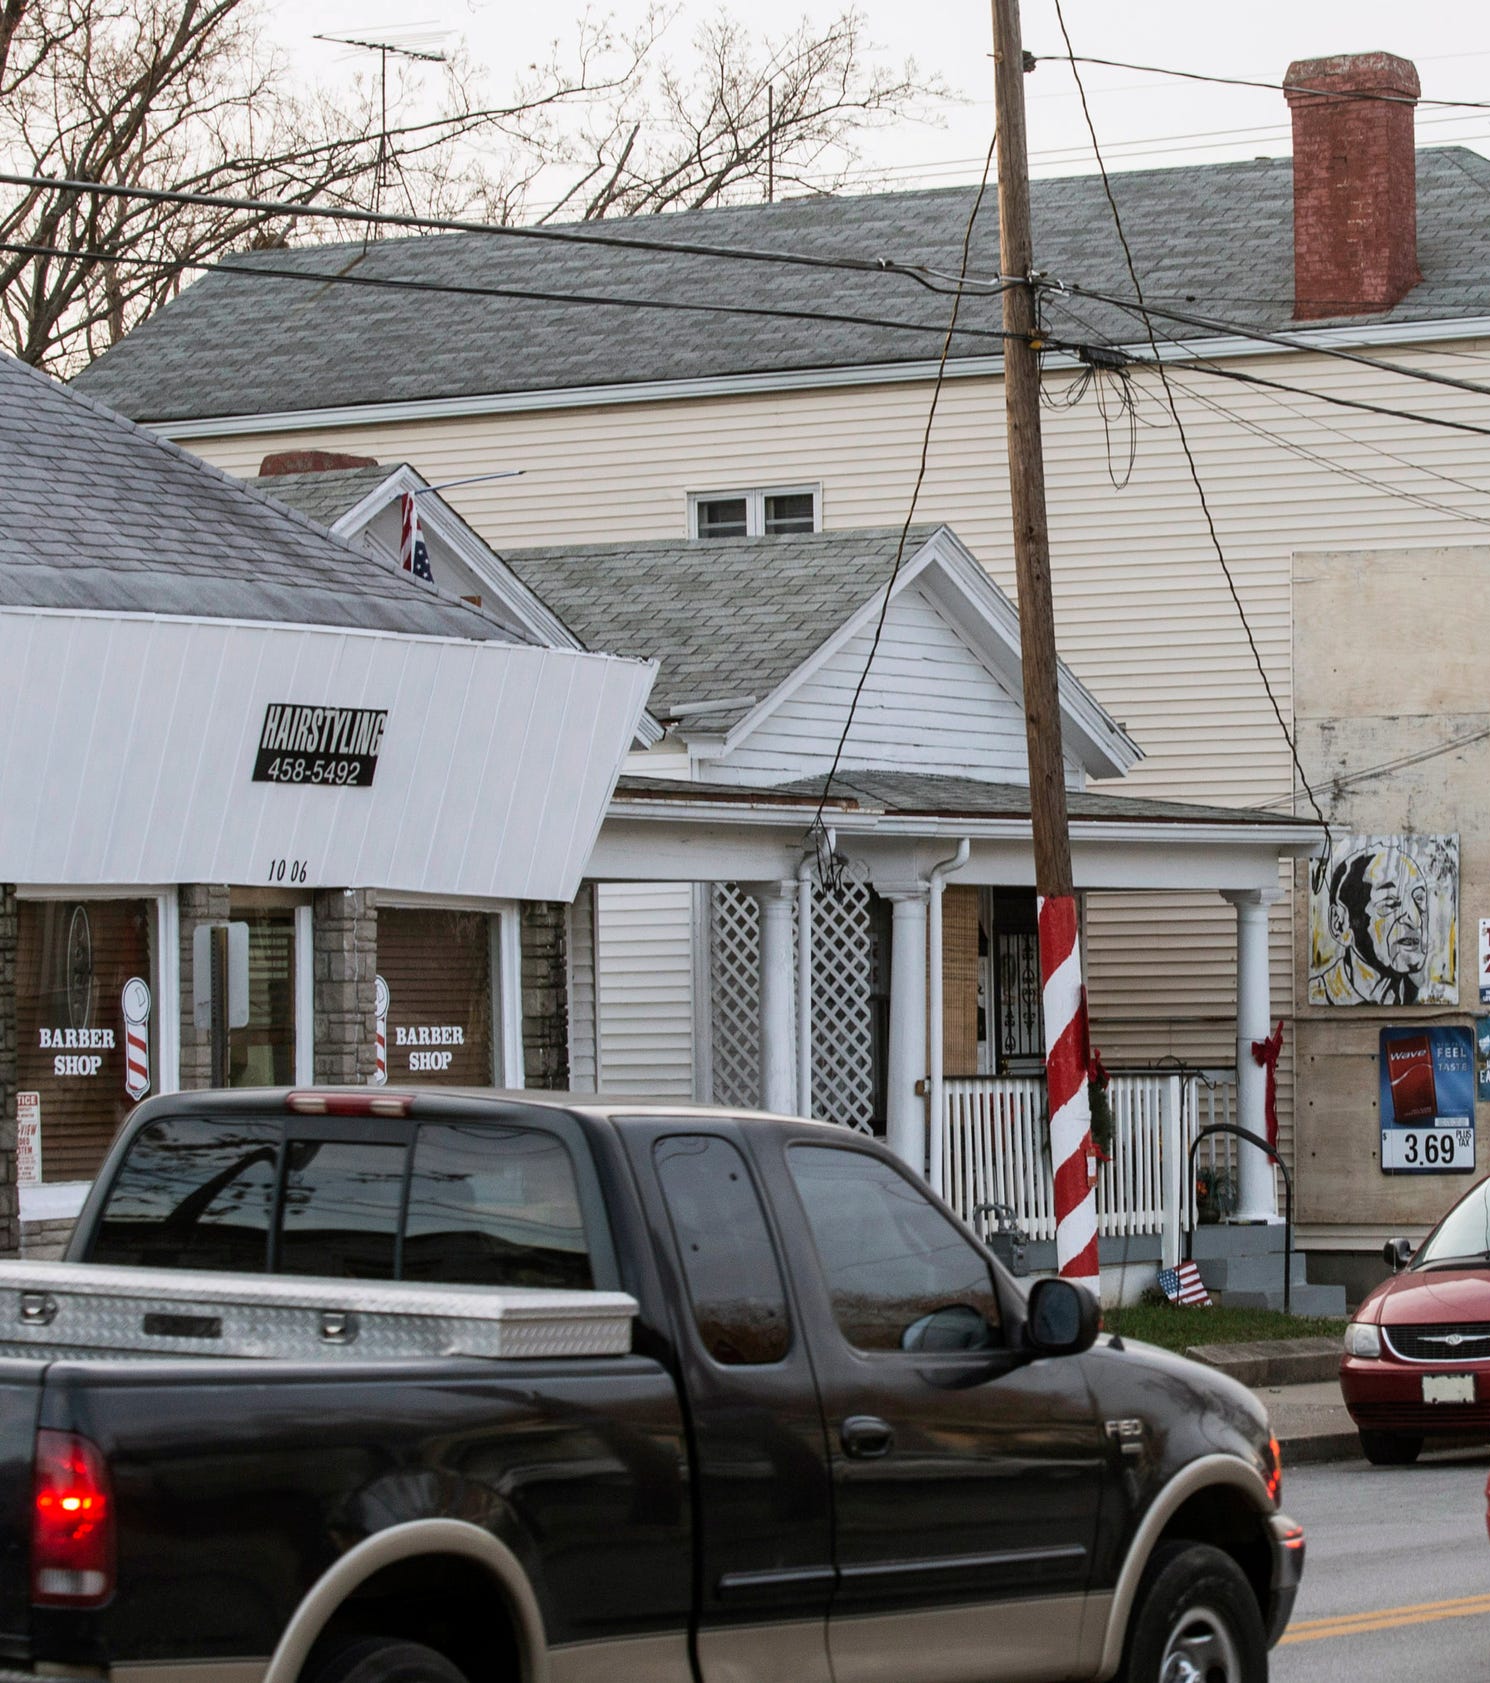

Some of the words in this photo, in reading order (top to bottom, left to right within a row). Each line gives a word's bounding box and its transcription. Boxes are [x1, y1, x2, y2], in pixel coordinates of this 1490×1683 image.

[261, 705, 388, 757] HAIRSTYLING
[268, 757, 361, 785] 458-5492
[39, 1028, 115, 1049] BARBER
[396, 1026, 464, 1045] BARBER
[409, 1051, 452, 1071] SHOP
[1437, 1047, 1467, 1058] FEEL
[54, 1055, 102, 1076] SHOP
[1439, 1063, 1468, 1071] TASTE
[18, 1096, 36, 1105] TICE
[1405, 1134, 1455, 1166] 3.69
[1456, 1130, 1471, 1138] PLUS
[1459, 1138, 1469, 1147] TAX
